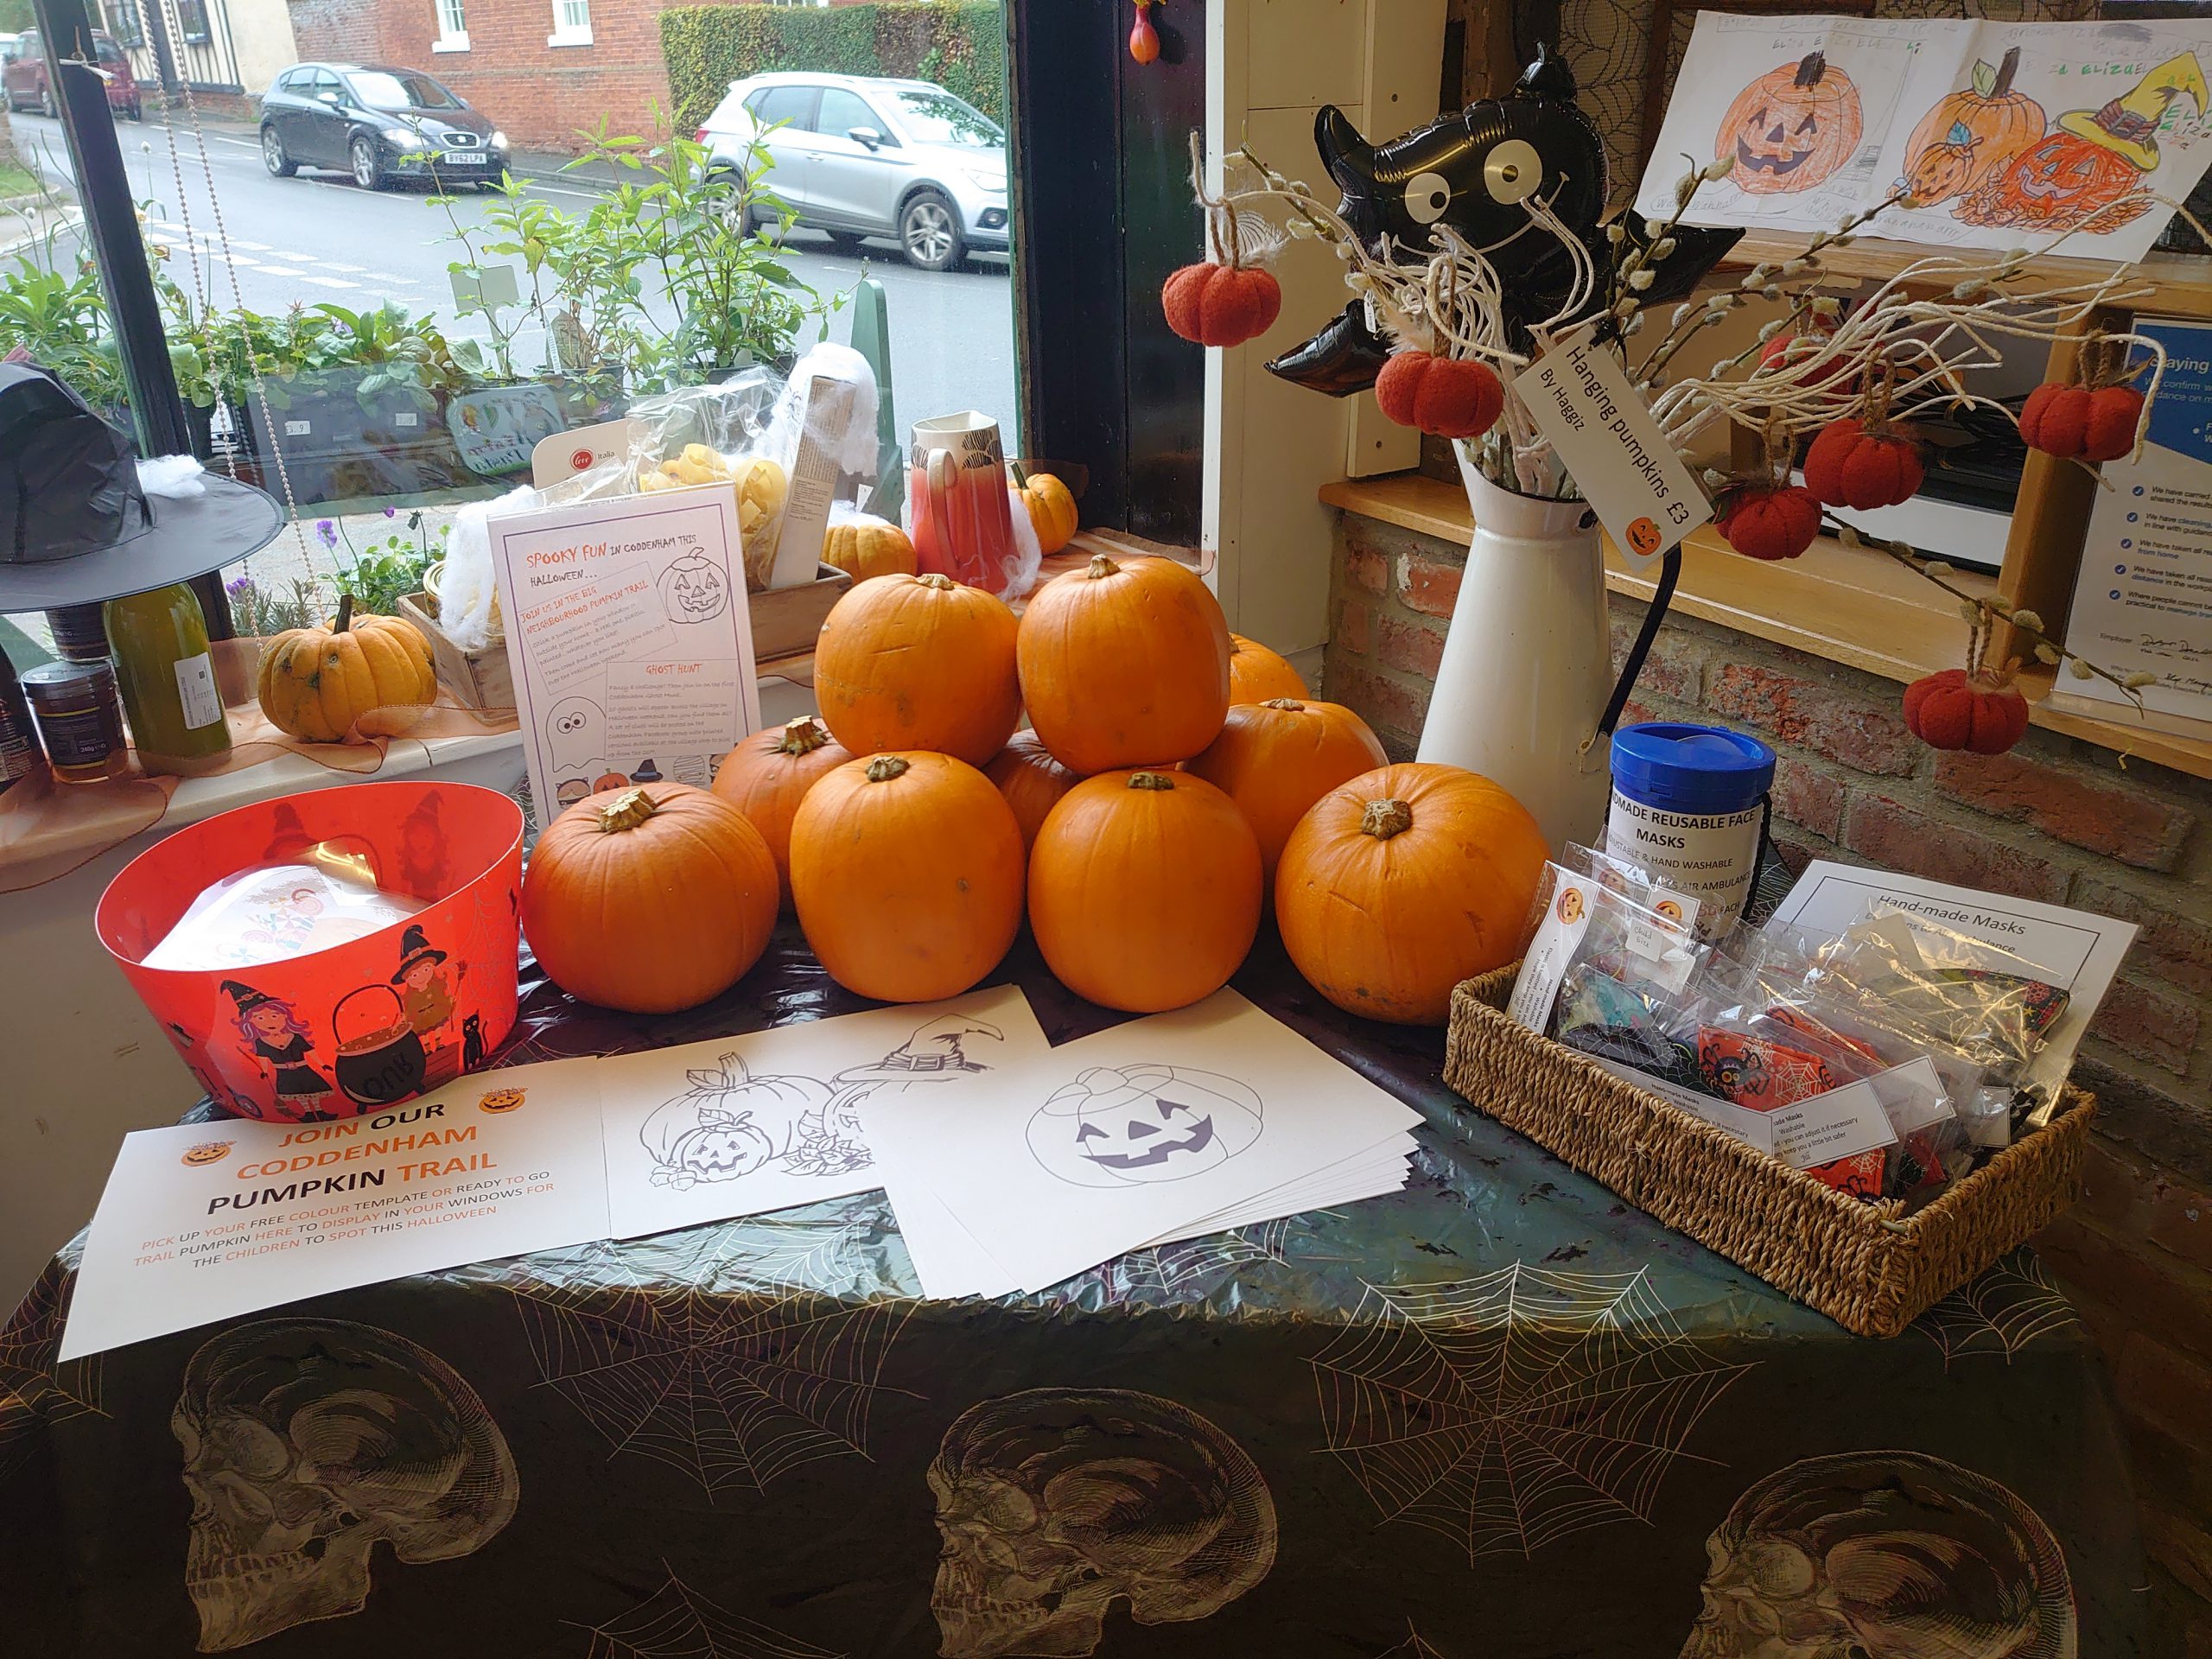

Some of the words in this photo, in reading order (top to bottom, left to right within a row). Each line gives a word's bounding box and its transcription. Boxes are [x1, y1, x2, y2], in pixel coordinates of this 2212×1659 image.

[2150, 357, 2209, 374] aying
[2163, 379, 2201, 391] confirm
[1539, 367, 1556, 390] By
[1552, 386, 1586, 432] Haggiz
[2189, 394, 2202, 403] on
[1565, 345, 1618, 423] Hanging
[1607, 417, 1670, 499] pumpkins
[1665, 500, 1690, 525] £3
[597, 450, 615, 460] Italia
[2150, 494, 2175, 505] shared
[2177, 498, 2189, 506] the
[2152, 486, 2164, 494] We
[2164, 486, 2183, 497] have
[2183, 489, 2211, 500] carried
[2158, 514, 2177, 524] have
[2166, 524, 2182, 533] with
[525, 545, 578, 569] SPOOKY
[582, 542, 607, 561] FUN
[609, 544, 621, 557] IN
[623, 537, 677, 553] CODDENHAM
[677, 534, 697, 545] THIS
[2137, 547, 2156, 556] from
[2157, 549, 2179, 560] home
[2152, 540, 2171, 550] have
[2171, 543, 2192, 554] taken
[2131, 574, 2164, 584] distance
[2173, 579, 2185, 588] the
[2146, 566, 2164, 575] have
[2164, 569, 2185, 580] taken
[519, 607, 540, 624] JOIN
[542, 603, 553, 613] US
[554, 599, 564, 610] IN
[564, 592, 581, 603] THE
[581, 585, 598, 599] BIG
[526, 602, 589, 634] NEIGHBOURHOOD
[589, 589, 623, 609] PUMPKIN
[626, 580, 649, 595] TRAIL
[2125, 599, 2157, 609] practical
[2127, 591, 2152, 601] Where
[2152, 594, 2177, 605] people
[2177, 598, 2204, 609] cannot
[645, 664, 676, 676] GHOST
[677, 663, 702, 674] HUNT
[1611, 790, 1648, 821] DMADE
[1650, 812, 1726, 830] REUSABLE
[1728, 809, 1757, 828] FACE
[1636, 828, 1686, 849] MASKS
[1642, 854, 1649, 862] &
[1651, 855, 1680, 868] HAND
[1682, 857, 1733, 870] WASHABLE
[1681, 880, 1699, 891] AIR
[1719, 900, 1741, 914] EACH
[1877, 894, 1969, 923] Hand-made
[1971, 913, 2027, 936] Masks
[1540, 978, 1554, 1009] Hand-made
[1529, 996, 1540, 1021] Washable
[1534, 1010, 1543, 1027] Masks
[1651, 1083, 1682, 1099] Hand-made
[1682, 1094, 1700, 1105] Masks
[277, 1121, 359, 1149] JOIN
[368, 1102, 446, 1131] OUR
[1785, 1111, 1804, 1123] Masks
[1778, 1122, 1806, 1135] Washable
[1783, 1136, 1795, 1146] you
[1795, 1132, 1804, 1141] can
[1804, 1127, 1821, 1138] adjust
[1830, 1116, 1859, 1131] necessary
[236, 1124, 479, 1180] CODDENHAM
[1783, 1146, 1797, 1157] keep
[1796, 1141, 1808, 1151] you
[1811, 1137, 1824, 1147] little
[1824, 1135, 1833, 1143] bit
[1833, 1130, 1847, 1141] safer
[206, 1167, 386, 1216] PUMPKIN
[397, 1152, 499, 1183] TRAIL
[141, 1235, 175, 1253] PICK
[178, 1229, 201, 1243] UP
[203, 1221, 246, 1239] YOUR
[250, 1214, 285, 1230] FREE
[288, 1204, 351, 1224] COLOUR
[353, 1190, 429, 1212] TEMPLATE
[431, 1185, 454, 1199] OR
[455, 1178, 503, 1195] READY
[505, 1175, 525, 1186] TO
[527, 1170, 550, 1183] GO
[132, 1249, 175, 1268] TRAIL
[178, 1234, 251, 1257] PUMPKIN
[254, 1226, 295, 1243] HERE
[296, 1222, 319, 1235] TO
[321, 1212, 382, 1230] DISPLAY
[385, 1207, 401, 1220] IN
[403, 1201, 445, 1217] YOUR
[446, 1187, 524, 1210] WINDOWS
[526, 1183, 556, 1196] FOR
[191, 1254, 223, 1269] THE
[224, 1239, 301, 1262] CHILDREN
[303, 1234, 326, 1247] TO
[327, 1226, 368, 1243] SPOT
[369, 1220, 404, 1235] THIS
[406, 1205, 499, 1230] HALLOWEEN
